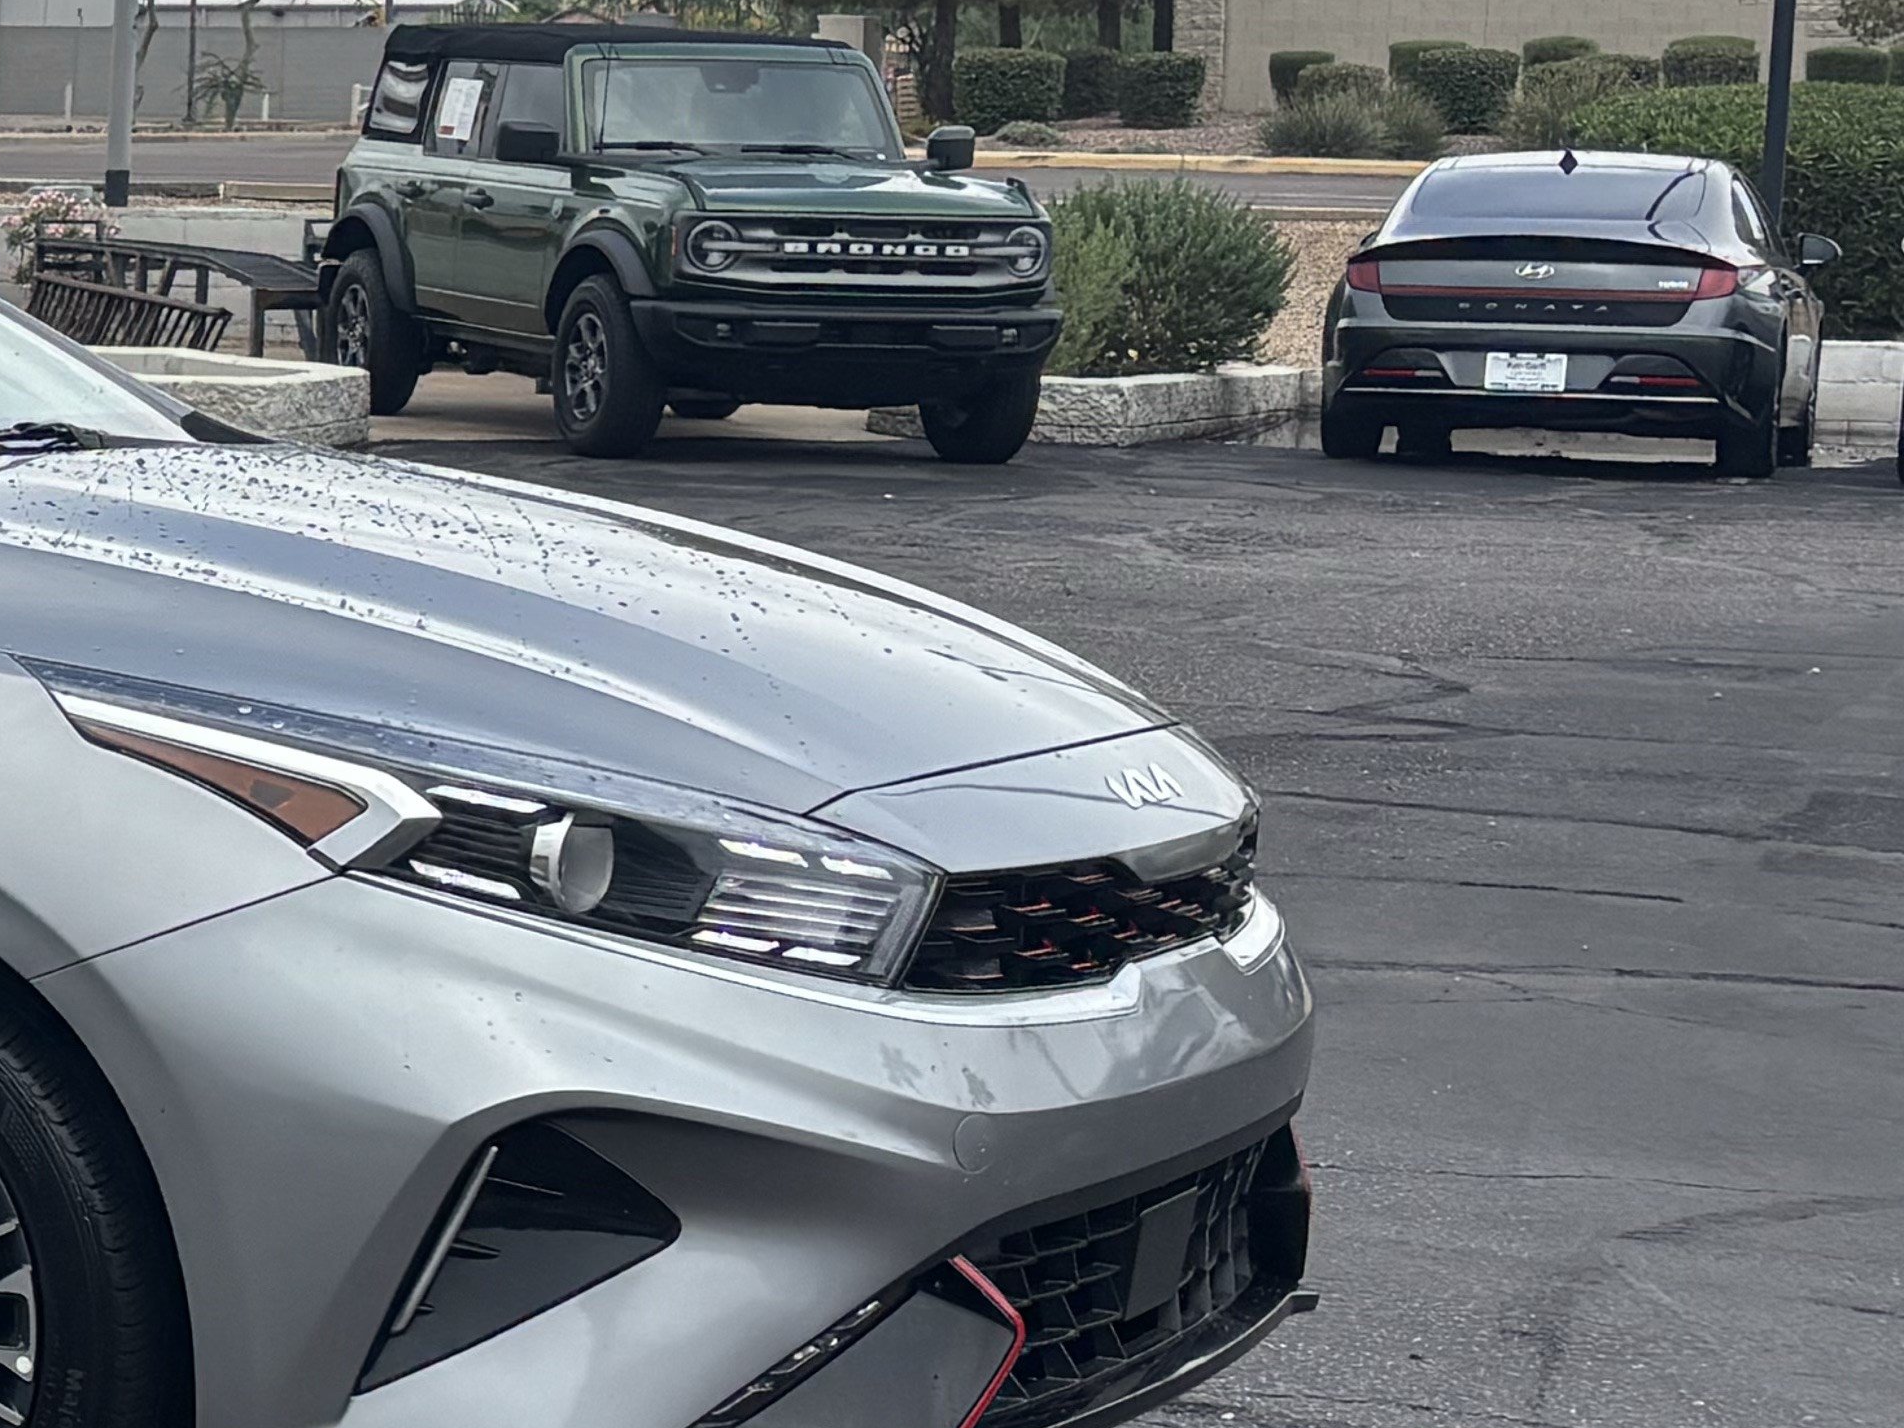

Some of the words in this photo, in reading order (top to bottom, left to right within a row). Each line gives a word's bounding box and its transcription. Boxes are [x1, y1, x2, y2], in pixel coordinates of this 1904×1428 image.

[783, 241, 970, 257] BRONCO
[1457, 301, 1609, 313] SONATA
[1104, 761, 1184, 810] KIA
